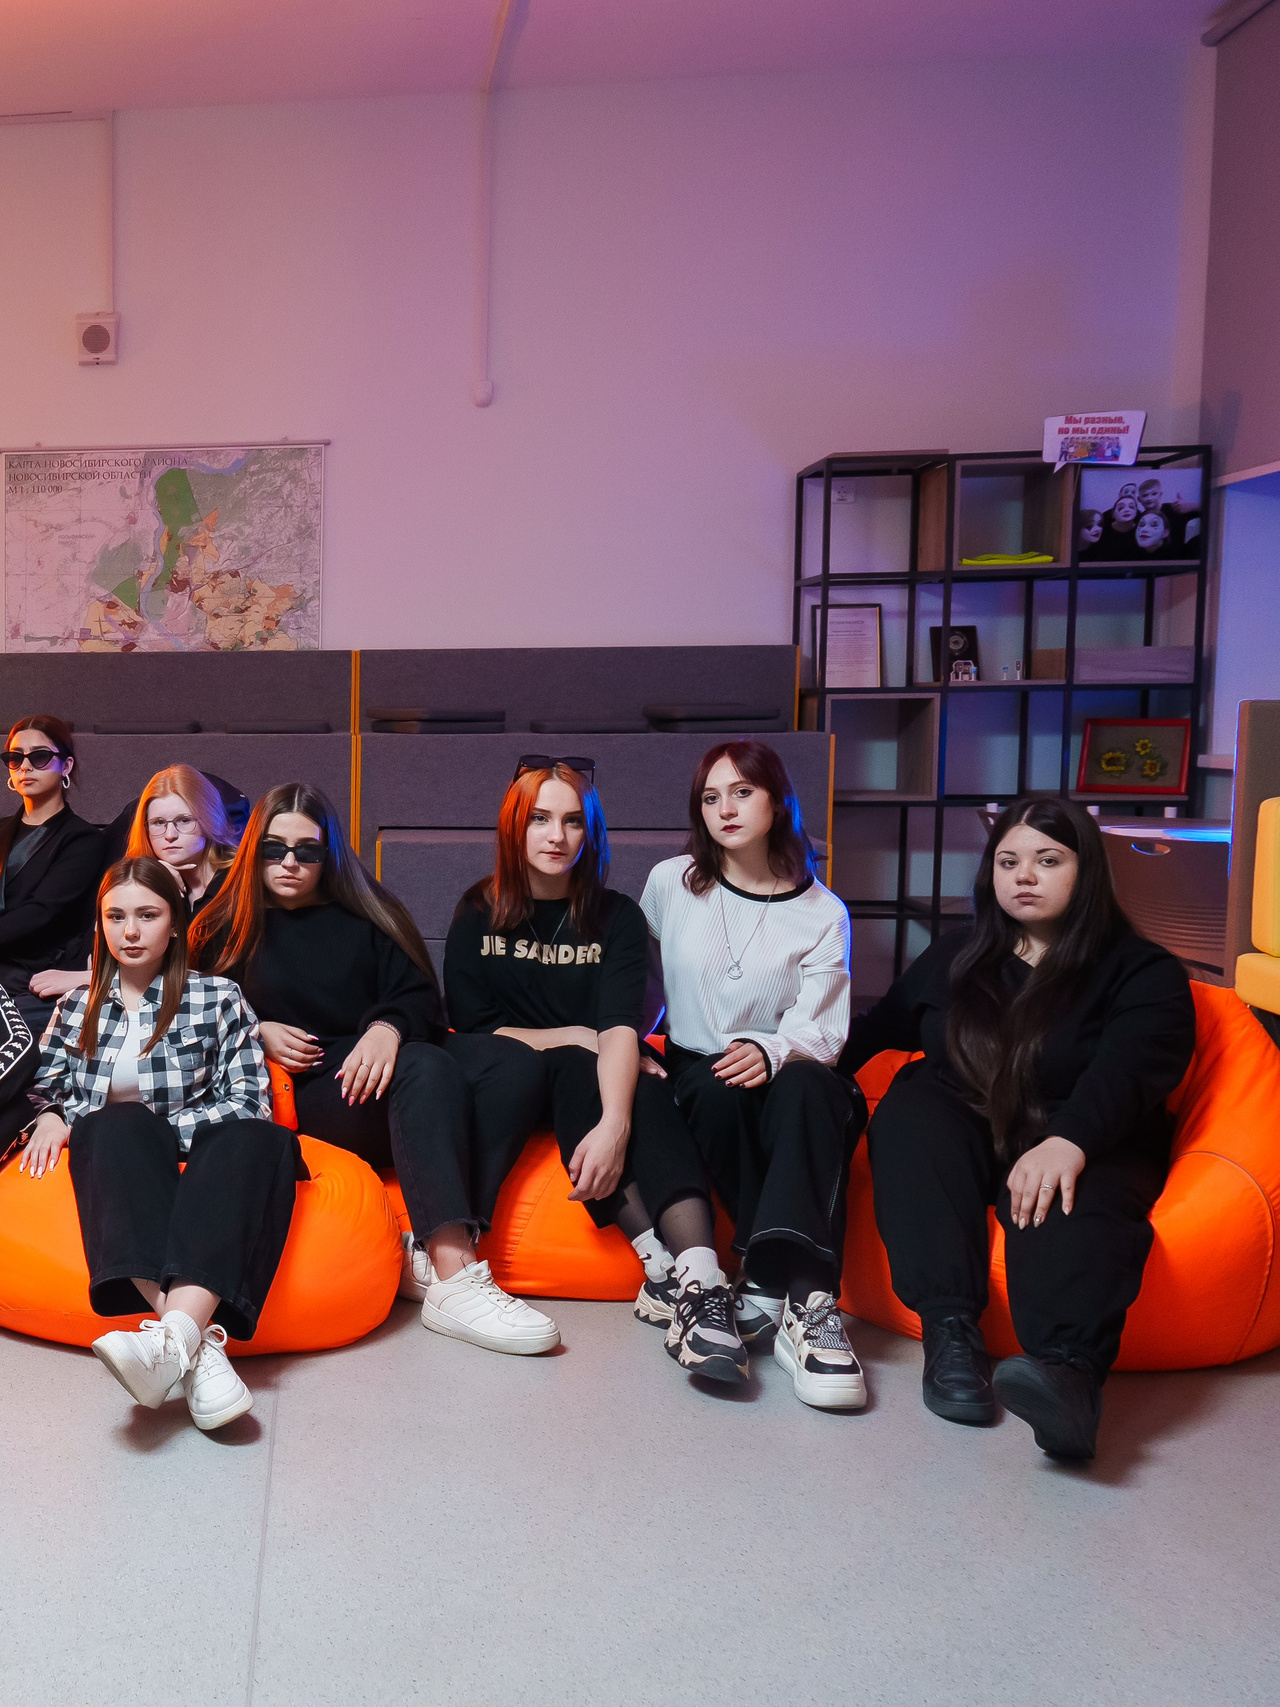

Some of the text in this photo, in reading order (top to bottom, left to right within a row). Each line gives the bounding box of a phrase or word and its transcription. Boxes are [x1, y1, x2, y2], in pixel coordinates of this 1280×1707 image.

[1065, 415, 1125, 425] Мы разные,
[1058, 425, 1130, 435] но мы едины!
[8, 457, 188, 469] КАРТА НОВОСИБИРСКОГО РАЙОНА
[8, 470, 152, 482] НОВОСИБИРСКОЙ ОБЛАСТИ
[513, 939, 602, 965] SANDER
